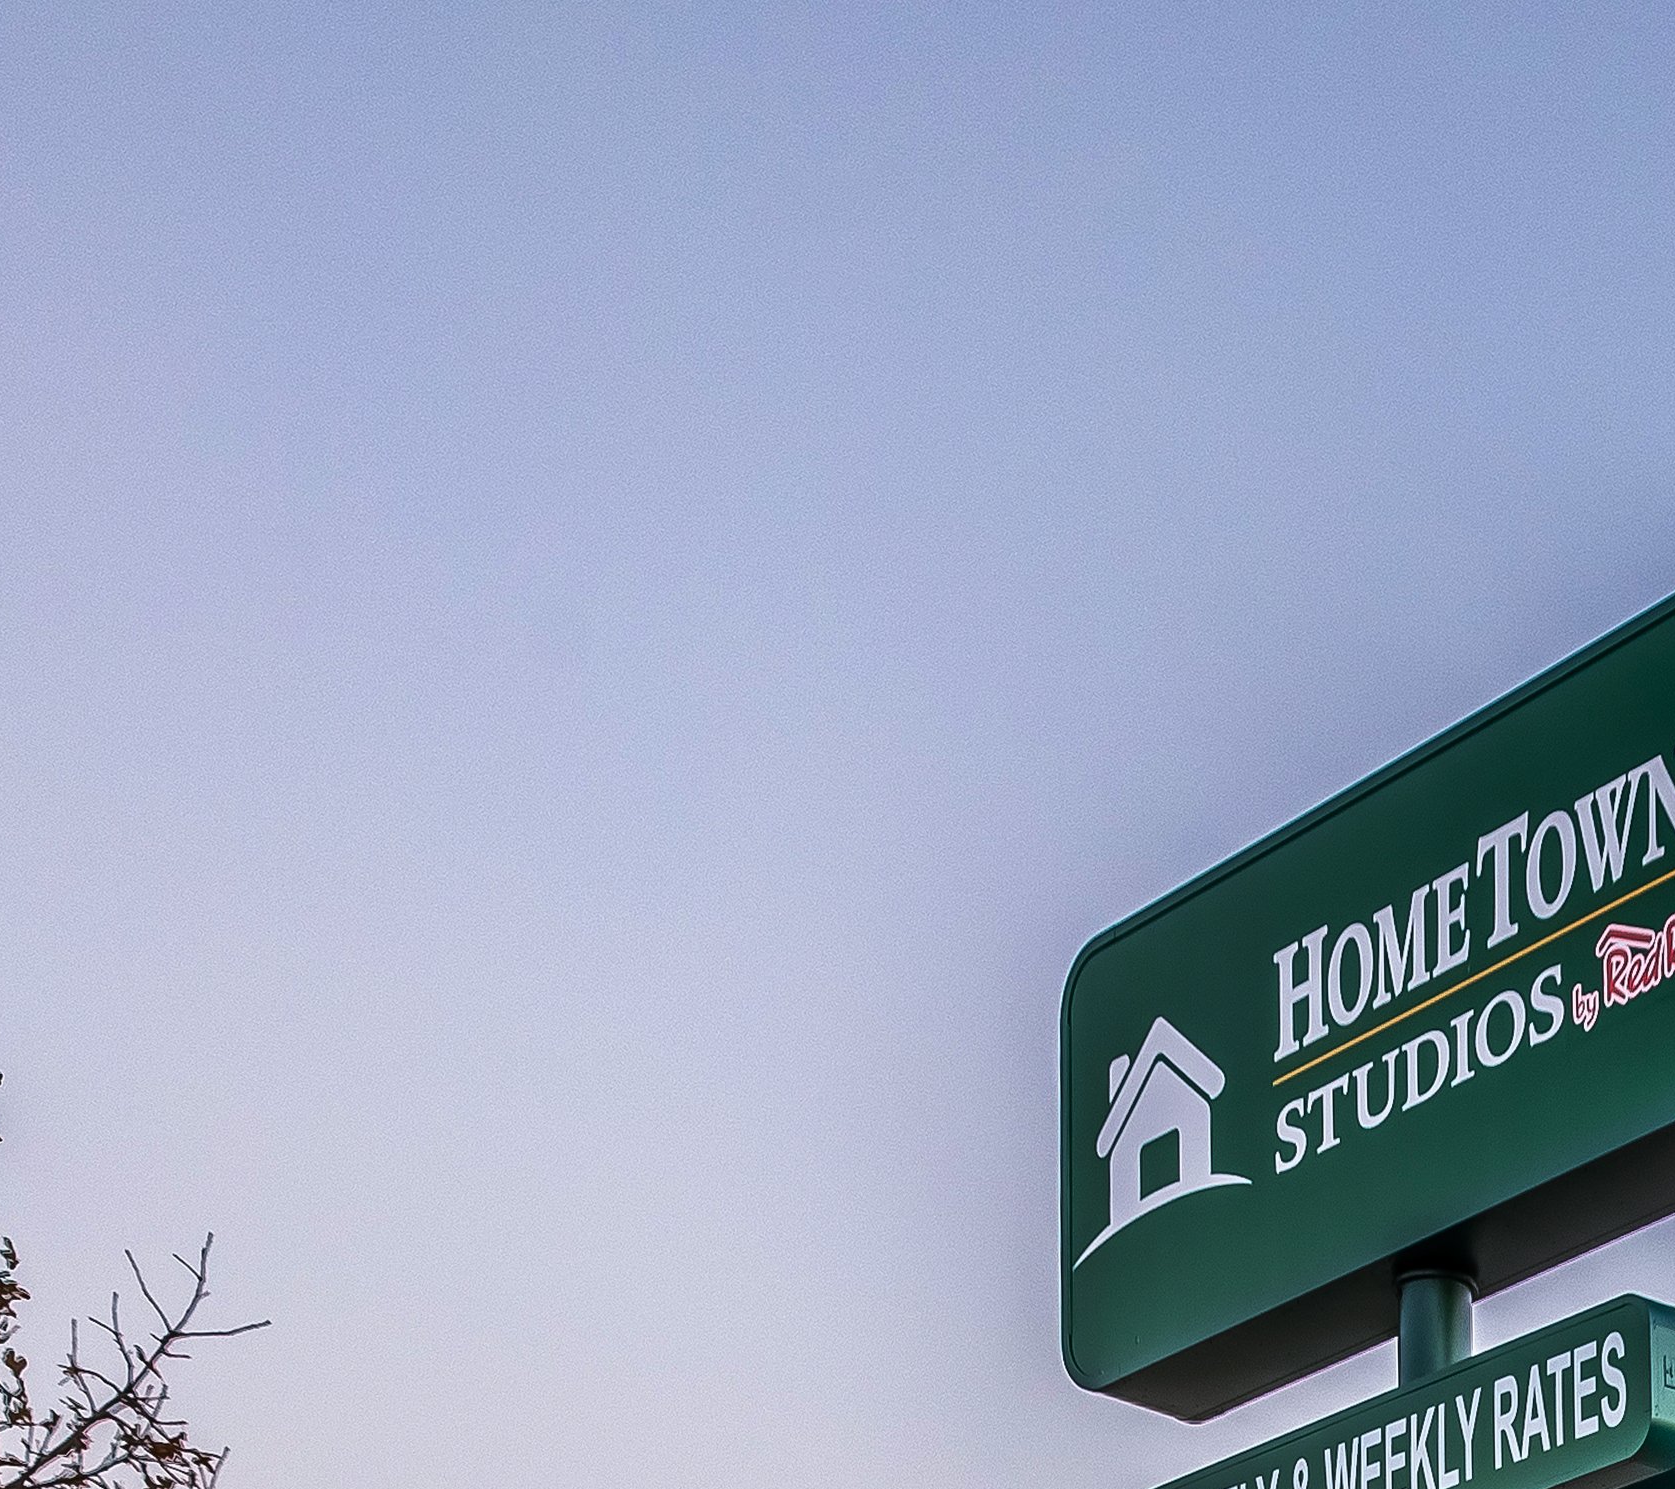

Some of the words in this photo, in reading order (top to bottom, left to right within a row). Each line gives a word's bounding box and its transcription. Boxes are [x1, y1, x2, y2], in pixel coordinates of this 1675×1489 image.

[1274, 963, 1565, 1175] STUDIOS
[1571, 983, 1600, 1032] by
[1493, 1331, 1627, 1470] RATES
